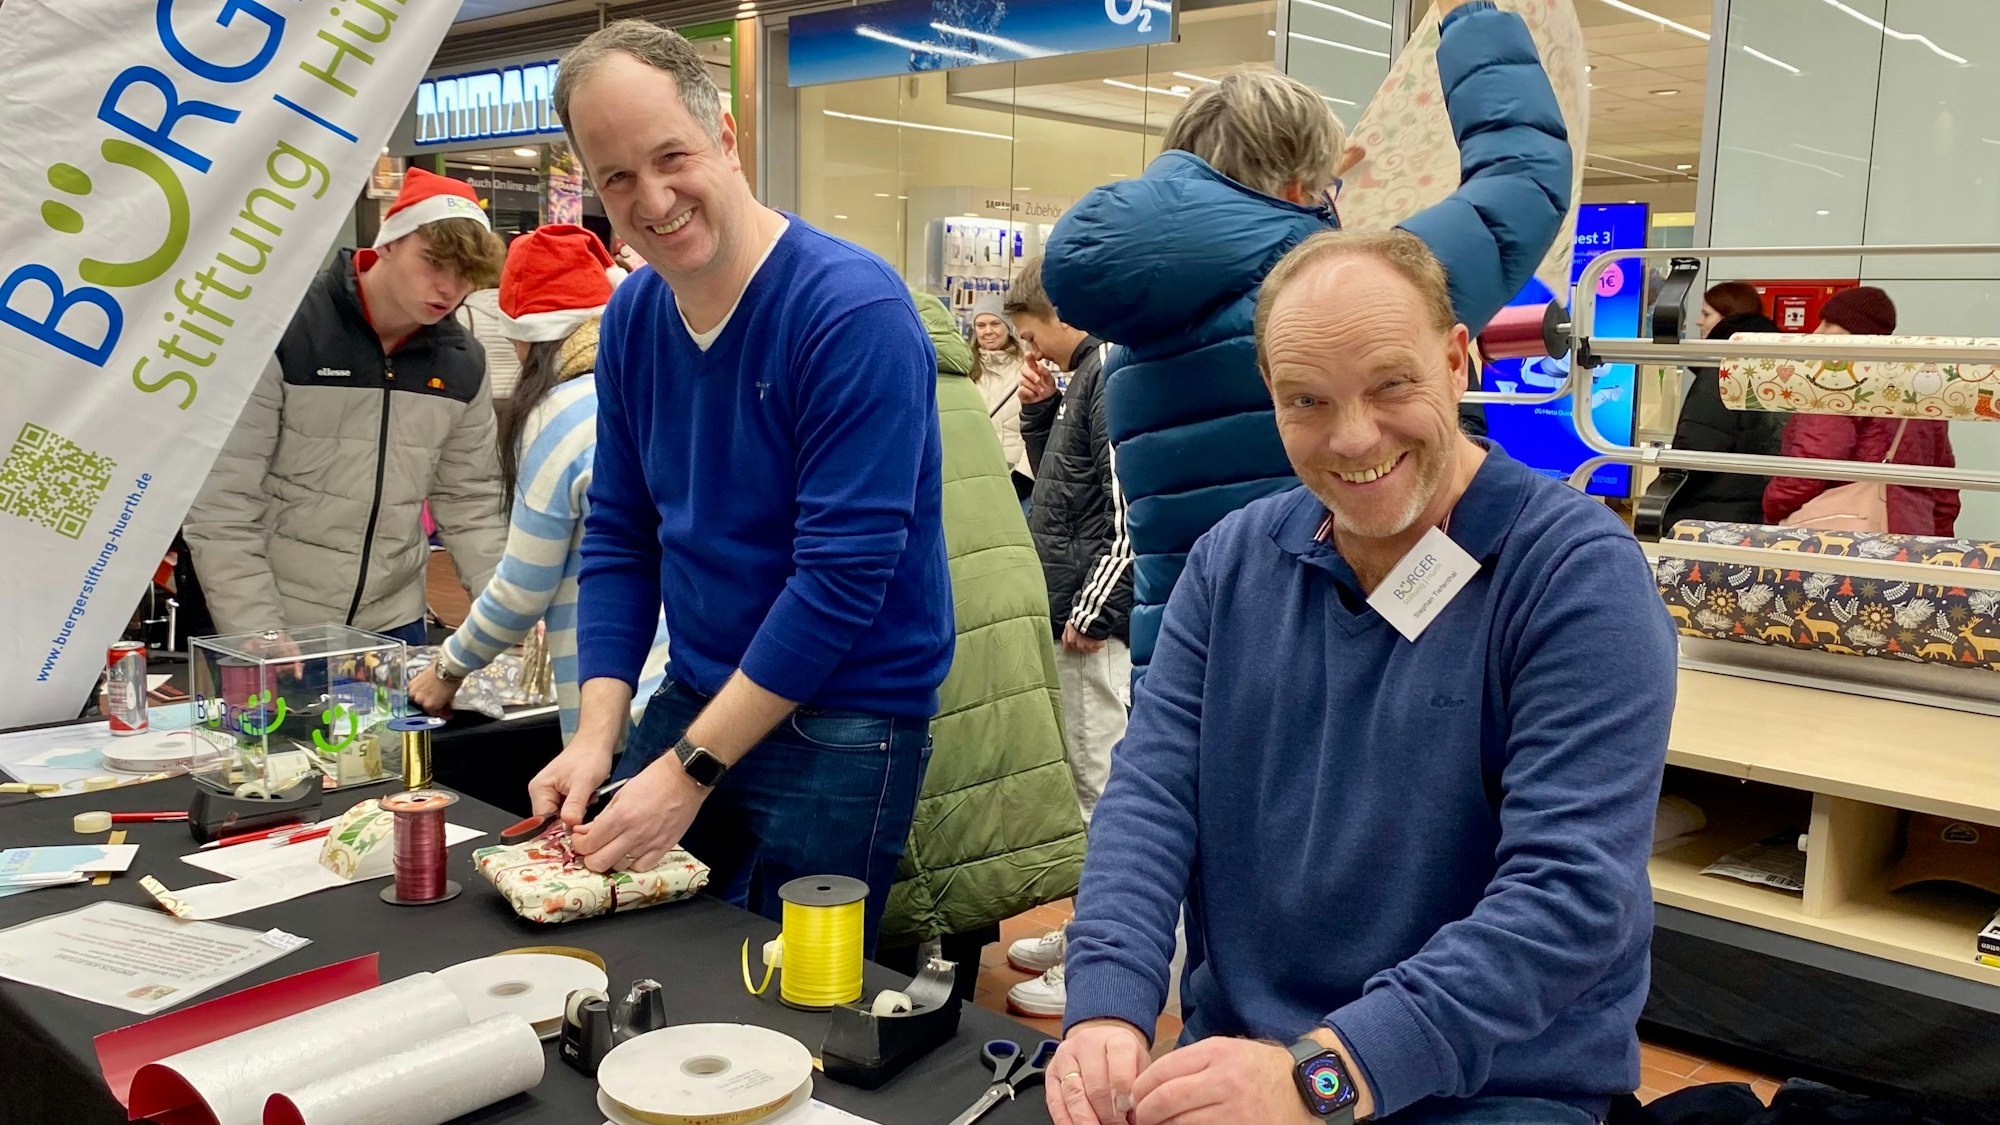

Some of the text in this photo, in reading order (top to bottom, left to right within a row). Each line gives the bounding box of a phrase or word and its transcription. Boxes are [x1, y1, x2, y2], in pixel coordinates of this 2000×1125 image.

[493, 180, 524, 191] Online
[133, 140, 330, 410] Stiftung
[300, 0, 403, 98] Hü
[1025, 202, 1061, 218] Zubehör
[1602, 231, 1611, 245] 3
[317, 367, 351, 376] ellesse
[37, 472, 152, 682] www.buergerstiftung-huerth.de
[1394, 554, 1437, 600] BÜRGER
[1413, 570, 1458, 618] Stephan Tiefenthal
